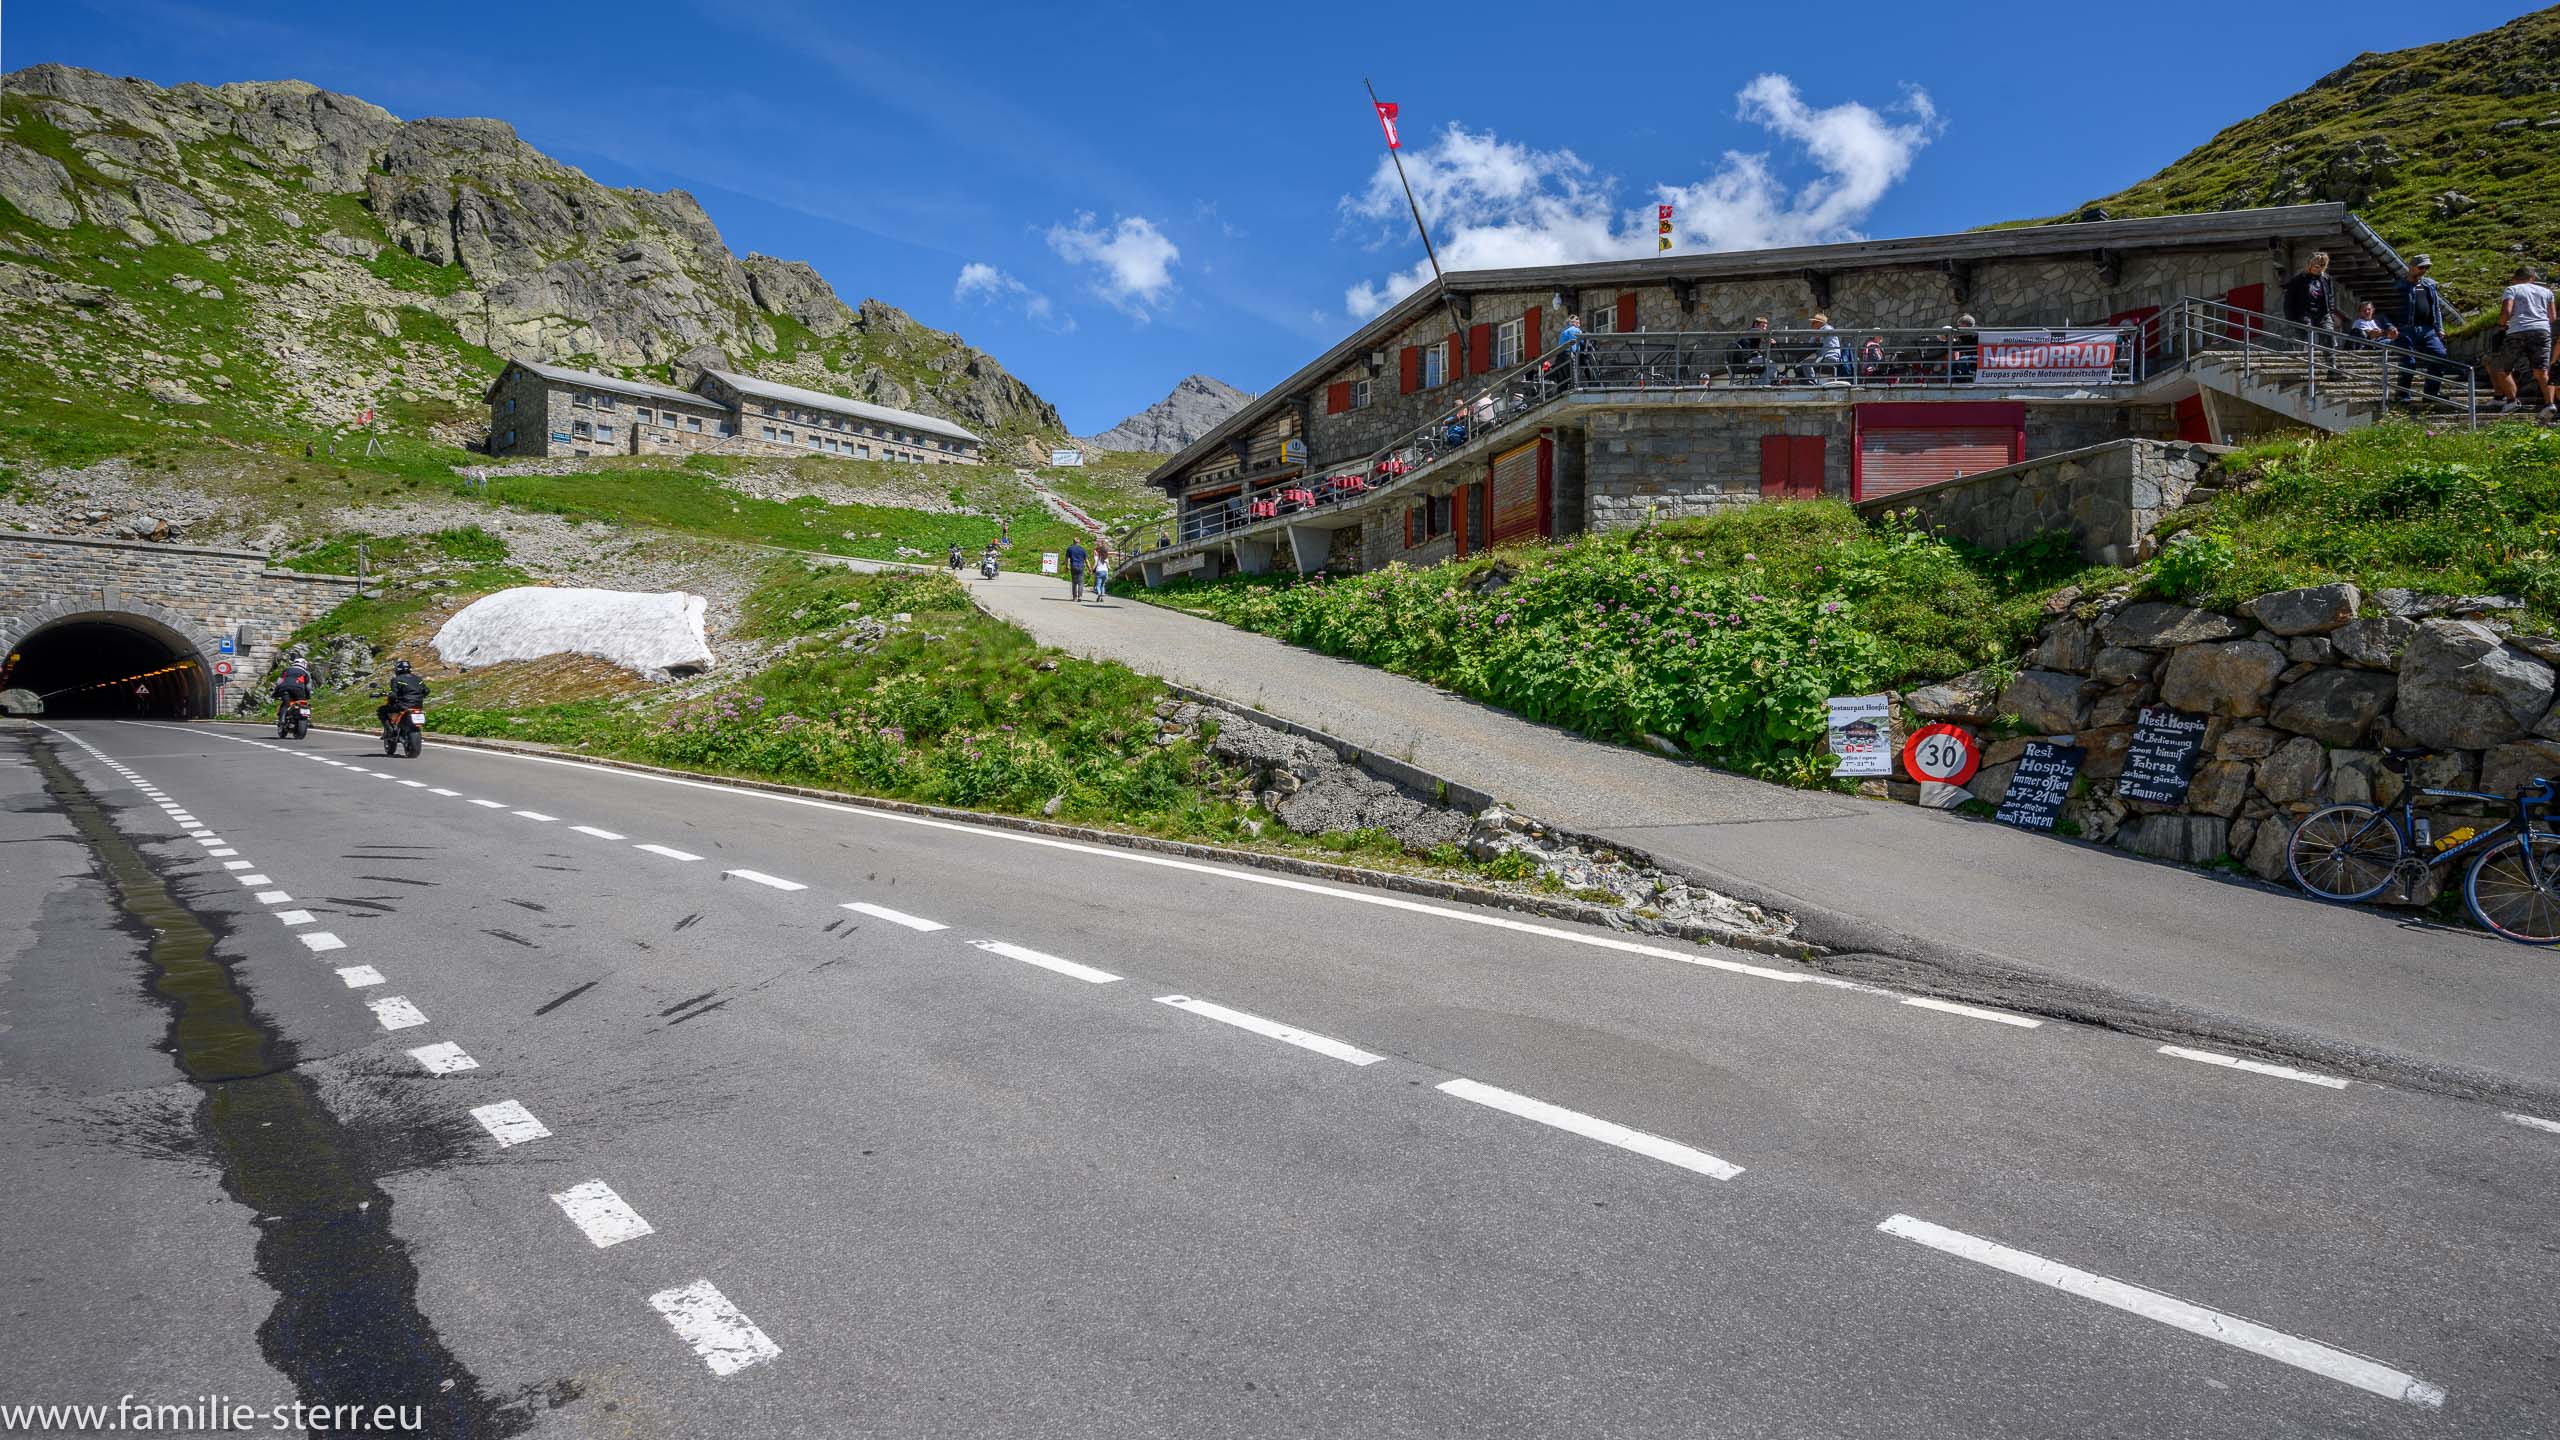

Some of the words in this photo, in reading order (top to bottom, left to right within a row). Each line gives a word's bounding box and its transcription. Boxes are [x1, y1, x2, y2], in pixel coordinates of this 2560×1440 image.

[1983, 345, 2111, 368] MOTORRAD
[1981, 370, 2010, 380] Europas
[2011, 370, 2036, 380] größte
[2037, 369, 2107, 378] Motorradzeitschrift
[2145, 733, 2193, 750] Bedienung
[1925, 744, 1957, 768] 30
[2155, 746, 2186, 762] hinauf
[2019, 758, 2075, 776] Hospiz
[2013, 773, 2042, 787] immer
[2041, 775, 2069, 791] offen
[2119, 780, 2173, 802] Zimmer
